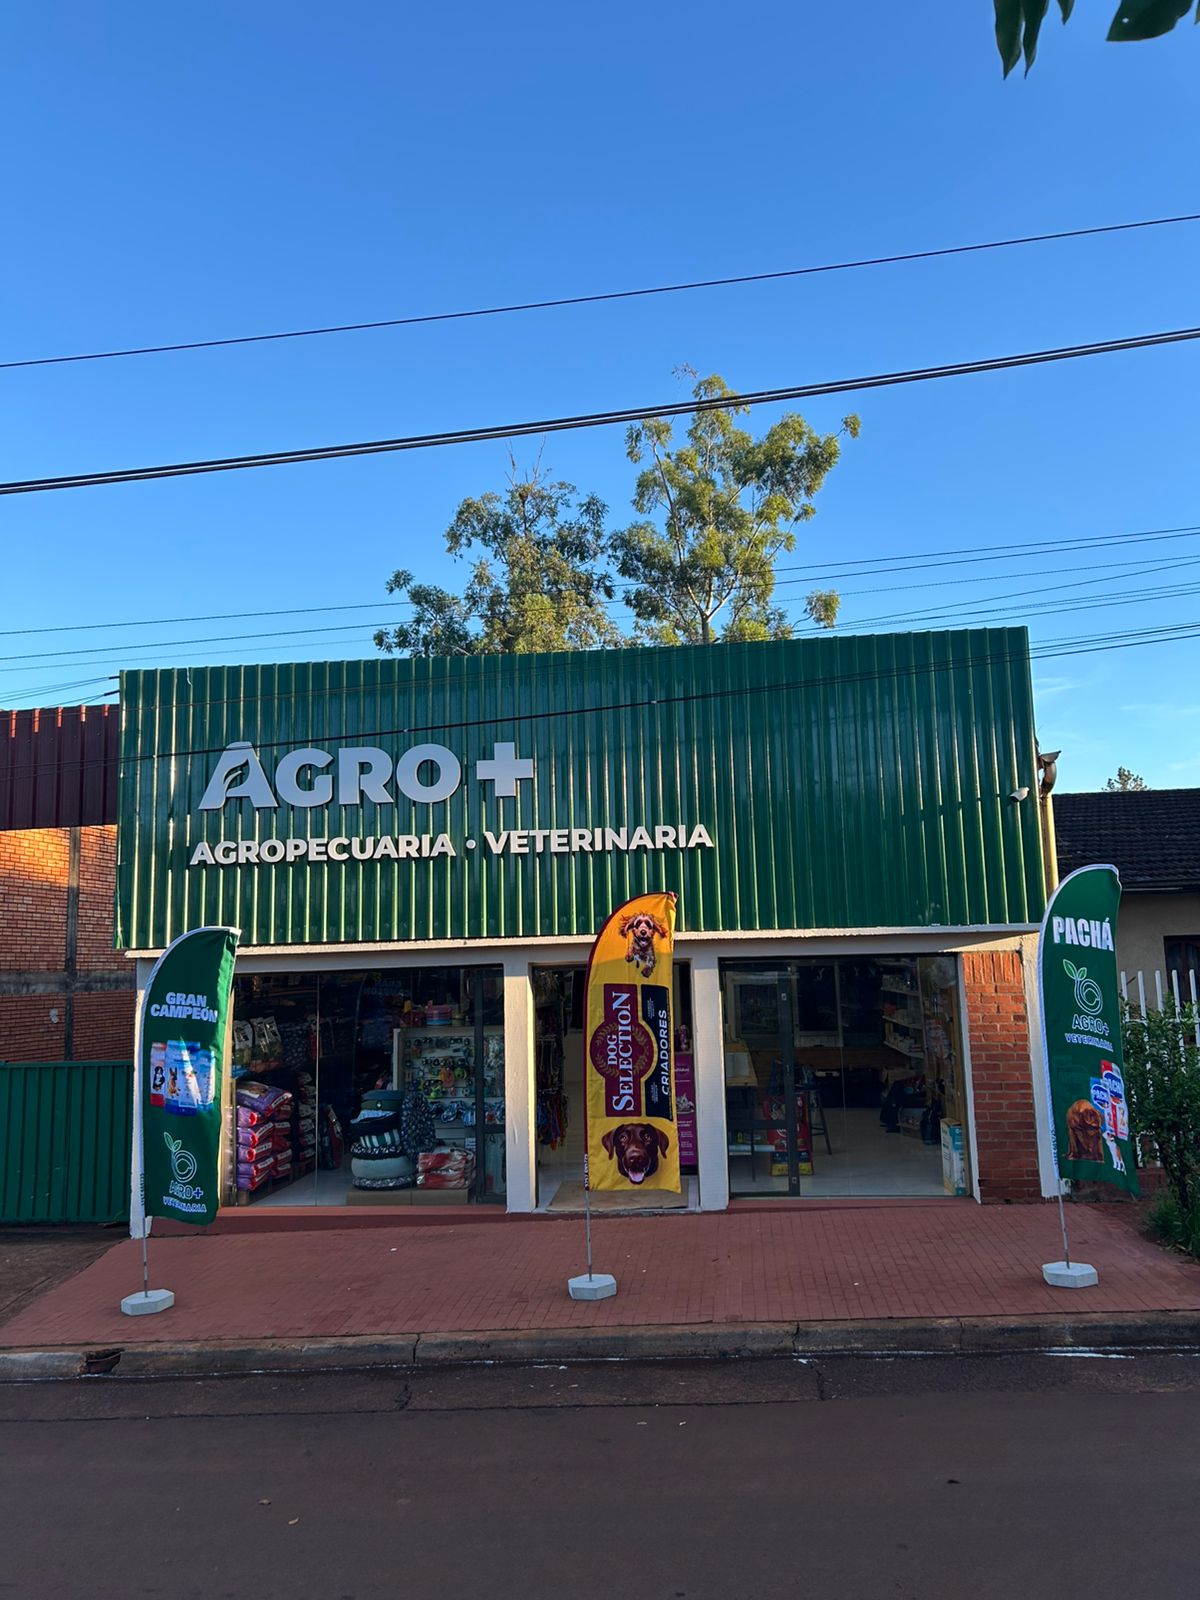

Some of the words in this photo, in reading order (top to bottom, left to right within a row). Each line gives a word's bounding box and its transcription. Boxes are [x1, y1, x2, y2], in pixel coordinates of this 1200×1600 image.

[189, 833, 457, 866] AGROPECUARIA
[484, 824, 714, 855] VETERINARIA
[1052, 916, 1115, 952] PACHÁ
[150, 1003, 219, 1023] CAMPEÓN
[166, 992, 208, 1008] GRAN
[607, 1034, 618, 1066] DOG
[612, 991, 635, 1112] SELECTION
[658, 1009, 671, 1096] CRIADORES
